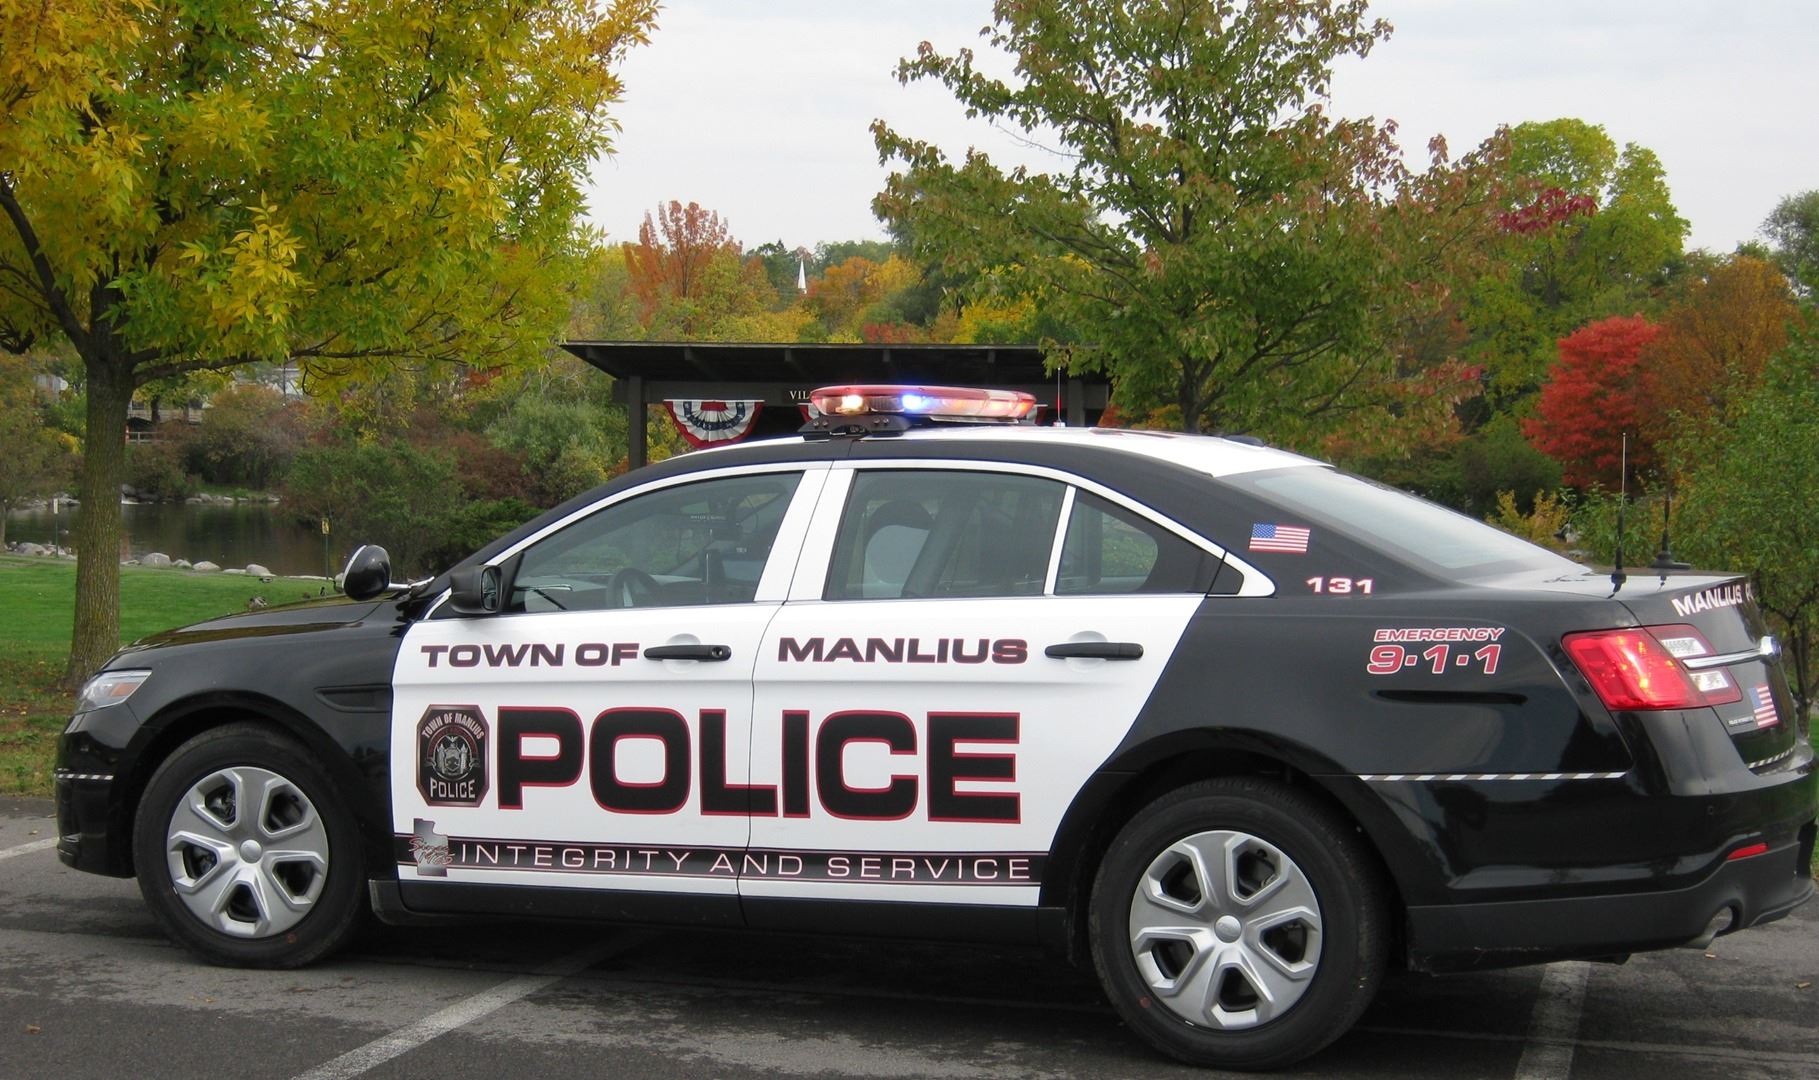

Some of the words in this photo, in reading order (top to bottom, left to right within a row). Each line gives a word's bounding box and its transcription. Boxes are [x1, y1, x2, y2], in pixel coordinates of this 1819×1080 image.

[1306, 576, 1374, 595] 131
[1671, 585, 1742, 616] MANLIUS
[1374, 627, 1505, 642] EMERGENCY
[421, 643, 565, 668] TOWN
[575, 642, 640, 667] OF
[777, 637, 1029, 665] MANLIUS
[422, 715, 443, 738] TOWN
[443, 712, 453, 724] OF
[454, 712, 485, 740] MANLIUS
[497, 705, 1022, 825] POLICE
[429, 776, 476, 799] POLICE
[461, 844, 690, 871] INTEGRITY
[709, 853, 803, 876] AND
[827, 857, 1030, 880] SERVICE
